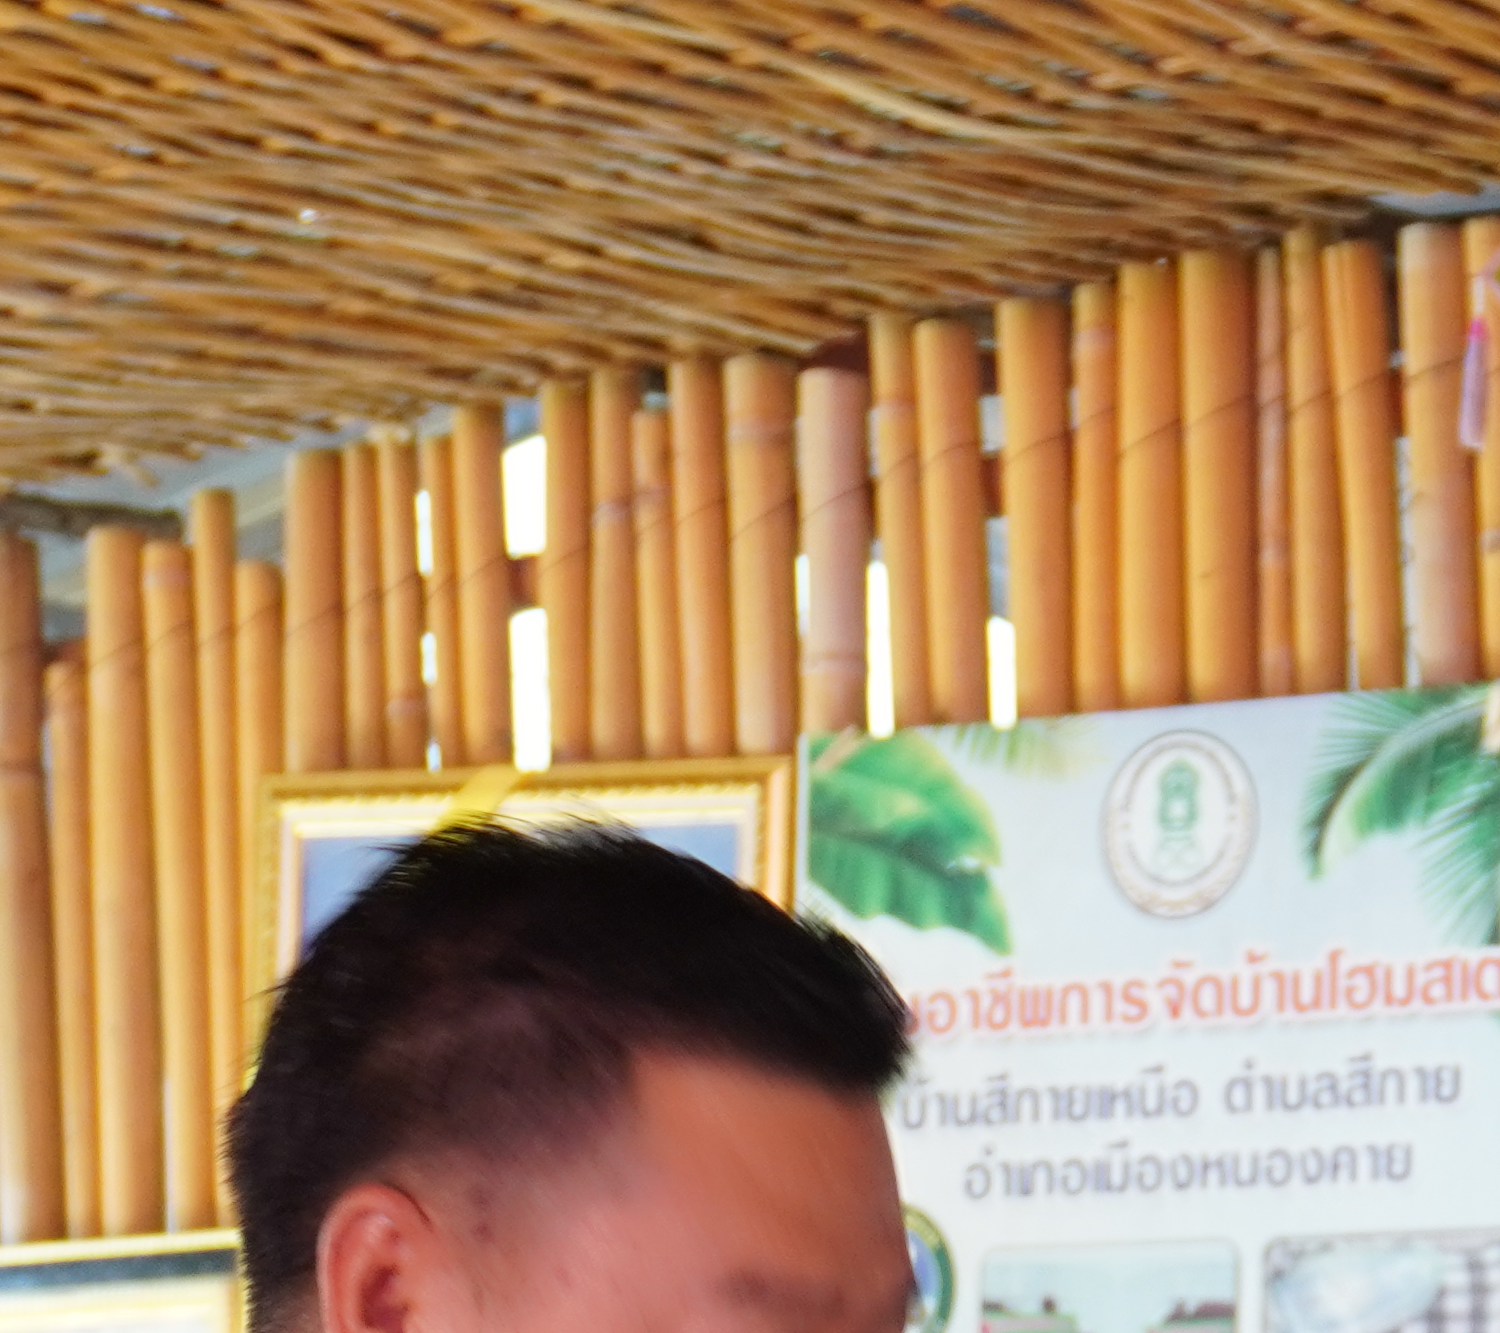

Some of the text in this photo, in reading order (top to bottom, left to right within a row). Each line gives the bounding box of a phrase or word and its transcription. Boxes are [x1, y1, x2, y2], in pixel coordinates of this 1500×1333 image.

[1224, 1053, 1462, 1115] ตำบลสีกาย
[964, 1139, 1413, 1200] อำเภอเมืองหนองคาย
